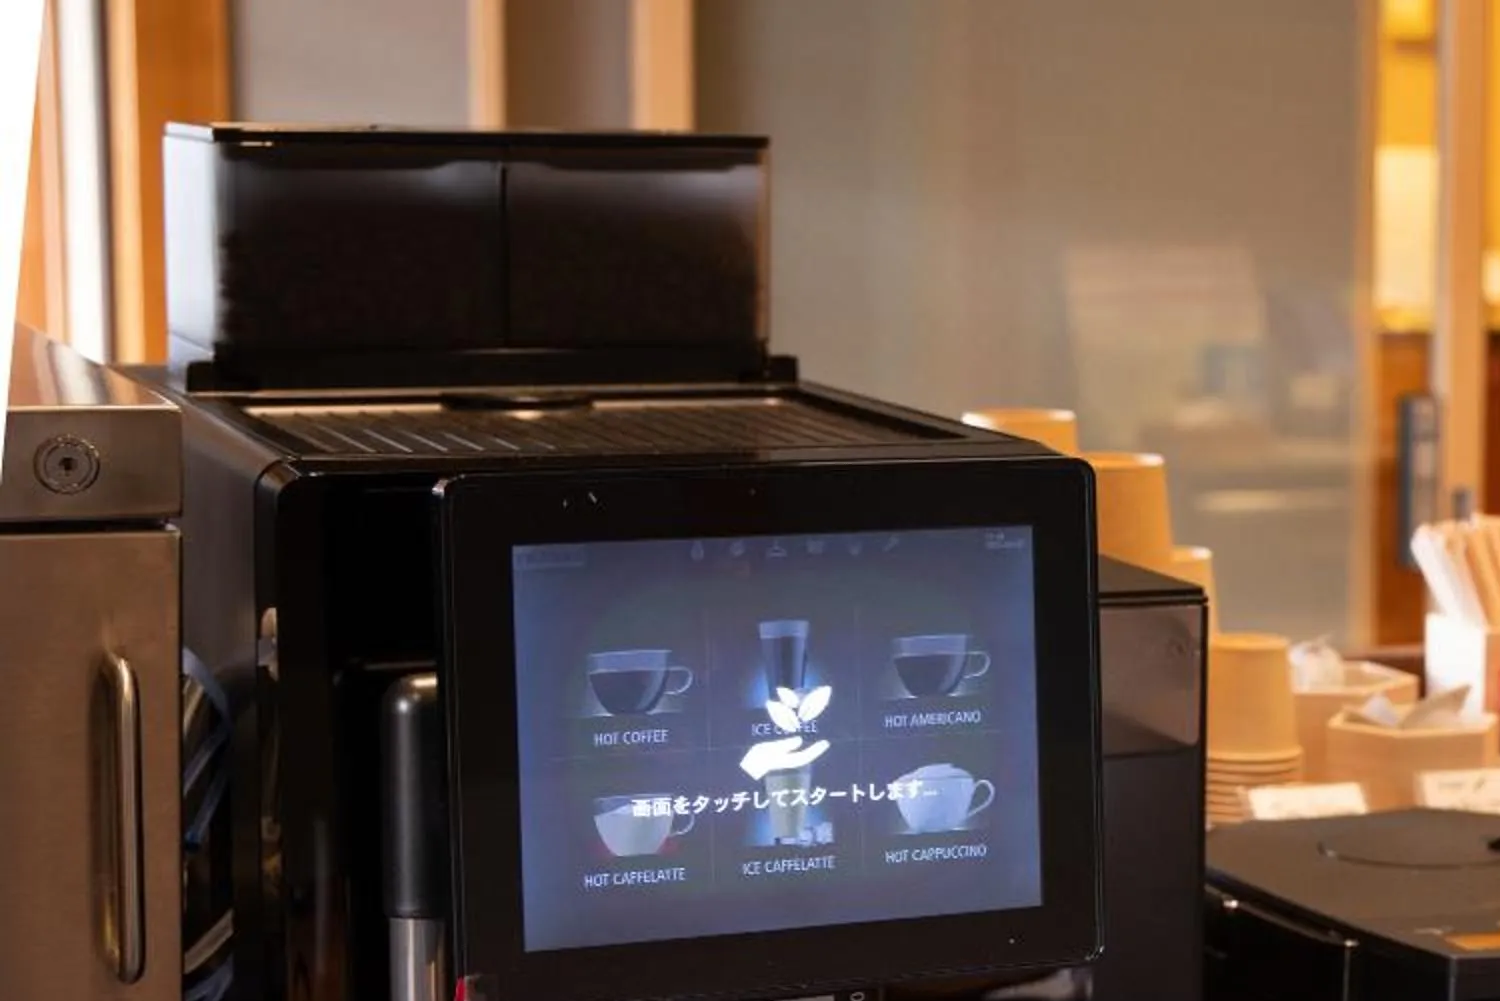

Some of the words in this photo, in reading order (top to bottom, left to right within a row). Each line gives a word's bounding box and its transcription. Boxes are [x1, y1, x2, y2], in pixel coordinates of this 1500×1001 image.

[752, 723, 770, 736] ICE
[774, 720, 817, 735] CFEE
[885, 714, 908, 728] HOT
[910, 710, 981, 727] AMERICANO
[593, 732, 619, 746] HOT
[623, 729, 669, 745] COFFEE
[885, 849, 909, 863] HOT
[911, 844, 987, 862] CAPPUCCINO
[743, 861, 761, 876] ICE
[764, 856, 836, 874] CAFFELATTE
[584, 873, 610, 889] HOT
[613, 868, 686, 887] CAFFELATTE
